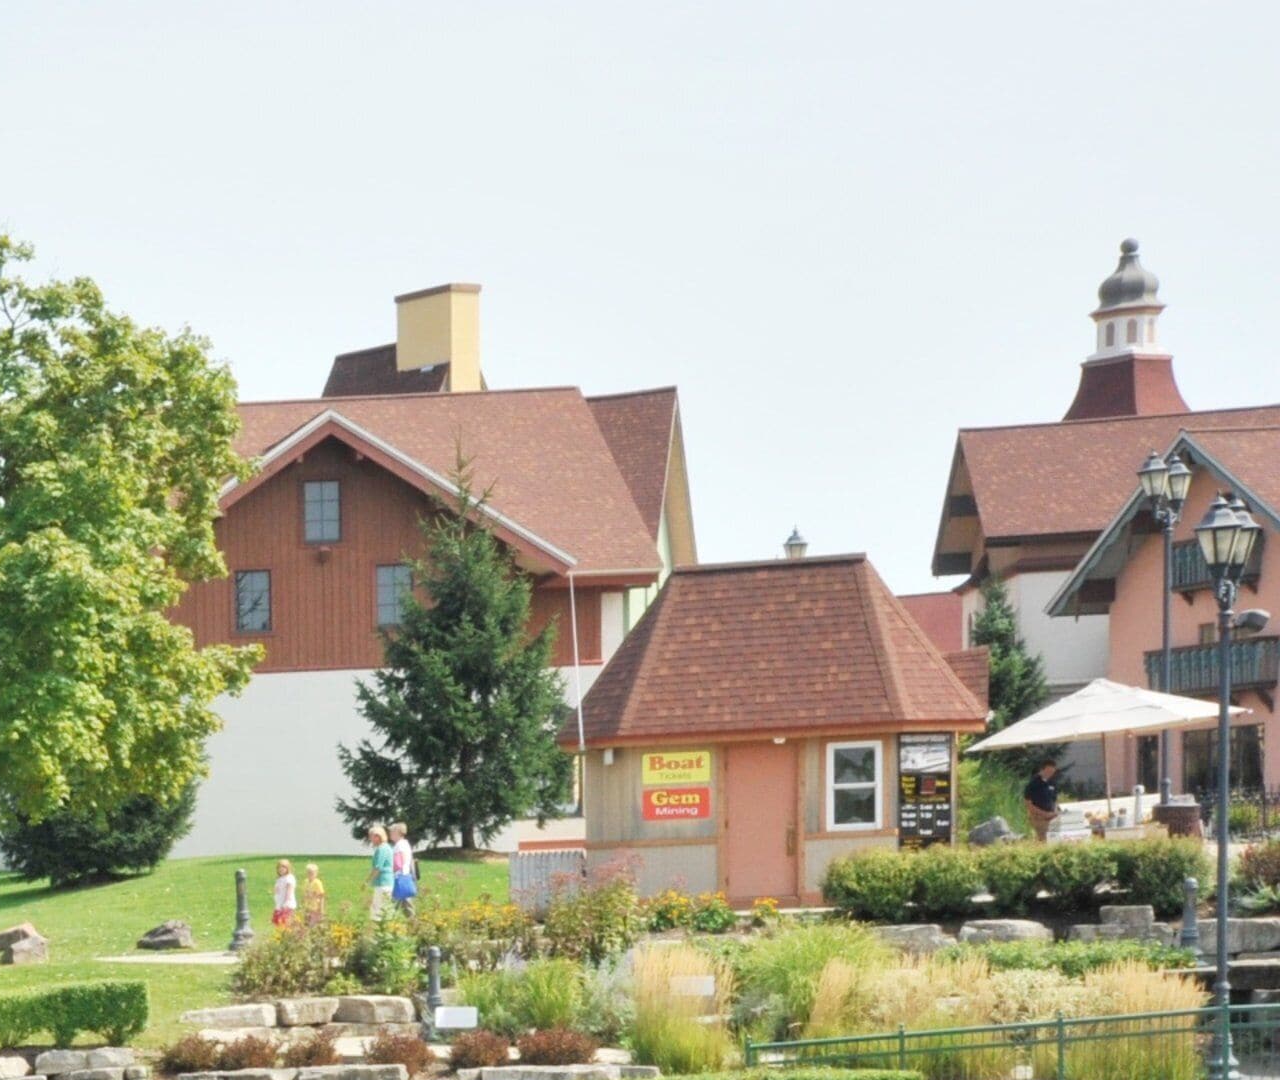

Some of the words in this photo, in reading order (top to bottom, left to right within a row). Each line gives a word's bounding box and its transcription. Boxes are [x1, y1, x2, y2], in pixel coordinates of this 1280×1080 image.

[648, 754, 704, 771] Boat
[651, 791, 701, 806] Gem
[655, 807, 698, 816] Mining
